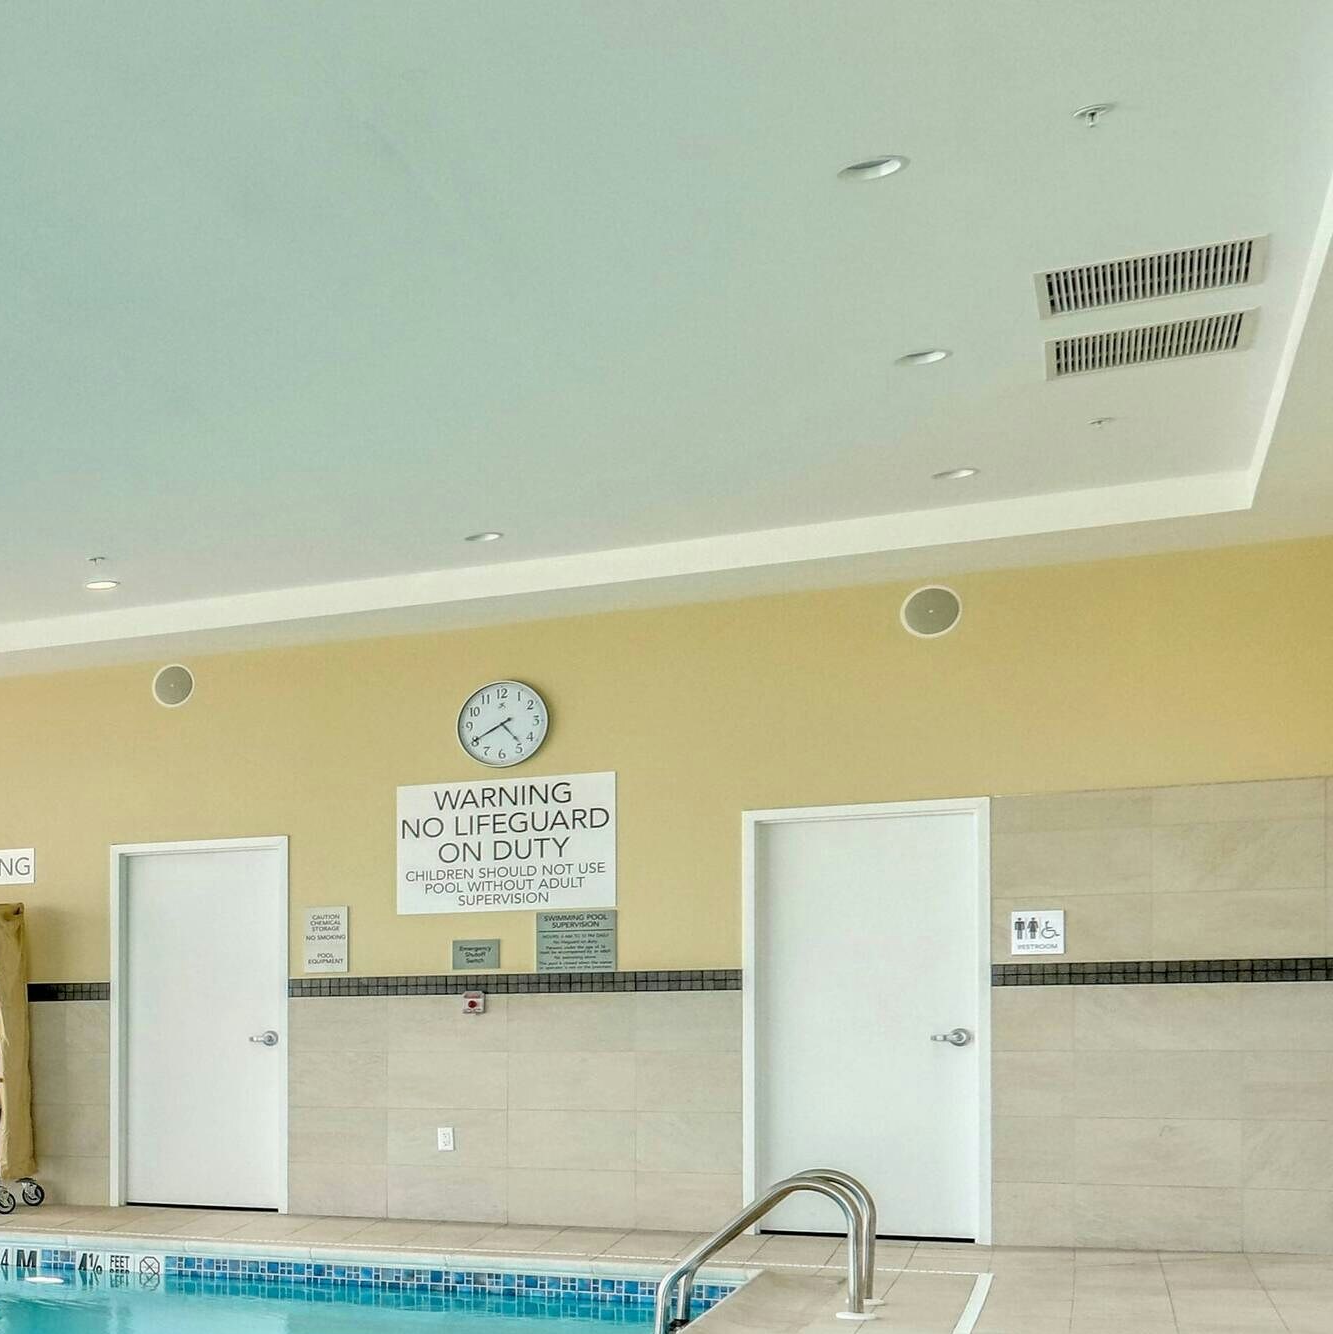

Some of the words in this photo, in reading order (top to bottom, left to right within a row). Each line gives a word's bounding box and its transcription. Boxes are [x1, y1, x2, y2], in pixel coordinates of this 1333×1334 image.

[482, 694, 490, 704] 11
[496, 688, 508, 699] 12
[526, 700, 534, 710] 2
[470, 706, 480, 717] 10
[533, 715, 540, 726] 3
[466, 722, 473, 732] 9
[526, 732, 533, 741] 4
[483, 746, 491, 756] 7
[515, 743, 523, 753] 5
[498, 749, 506, 759] 6
[434, 782, 572, 811] WARNING
[402, 817, 444, 840] NO
[455, 808, 610, 836] LIFEGUARD
[438, 842, 482, 864] ON
[493, 836, 570, 861] DUTY
[406, 868, 474, 882] CHILDREN
[478, 865, 538, 879] SHOULD
[542, 863, 574, 876] NOT
[578, 862, 606, 874] USE
[425, 882, 463, 894] POOL
[468, 879, 535, 893] WITHOUT
[538, 876, 586, 890] ADULT
[458, 892, 550, 907] SUPERVISION
[110, 1255, 130, 1268] FEET
